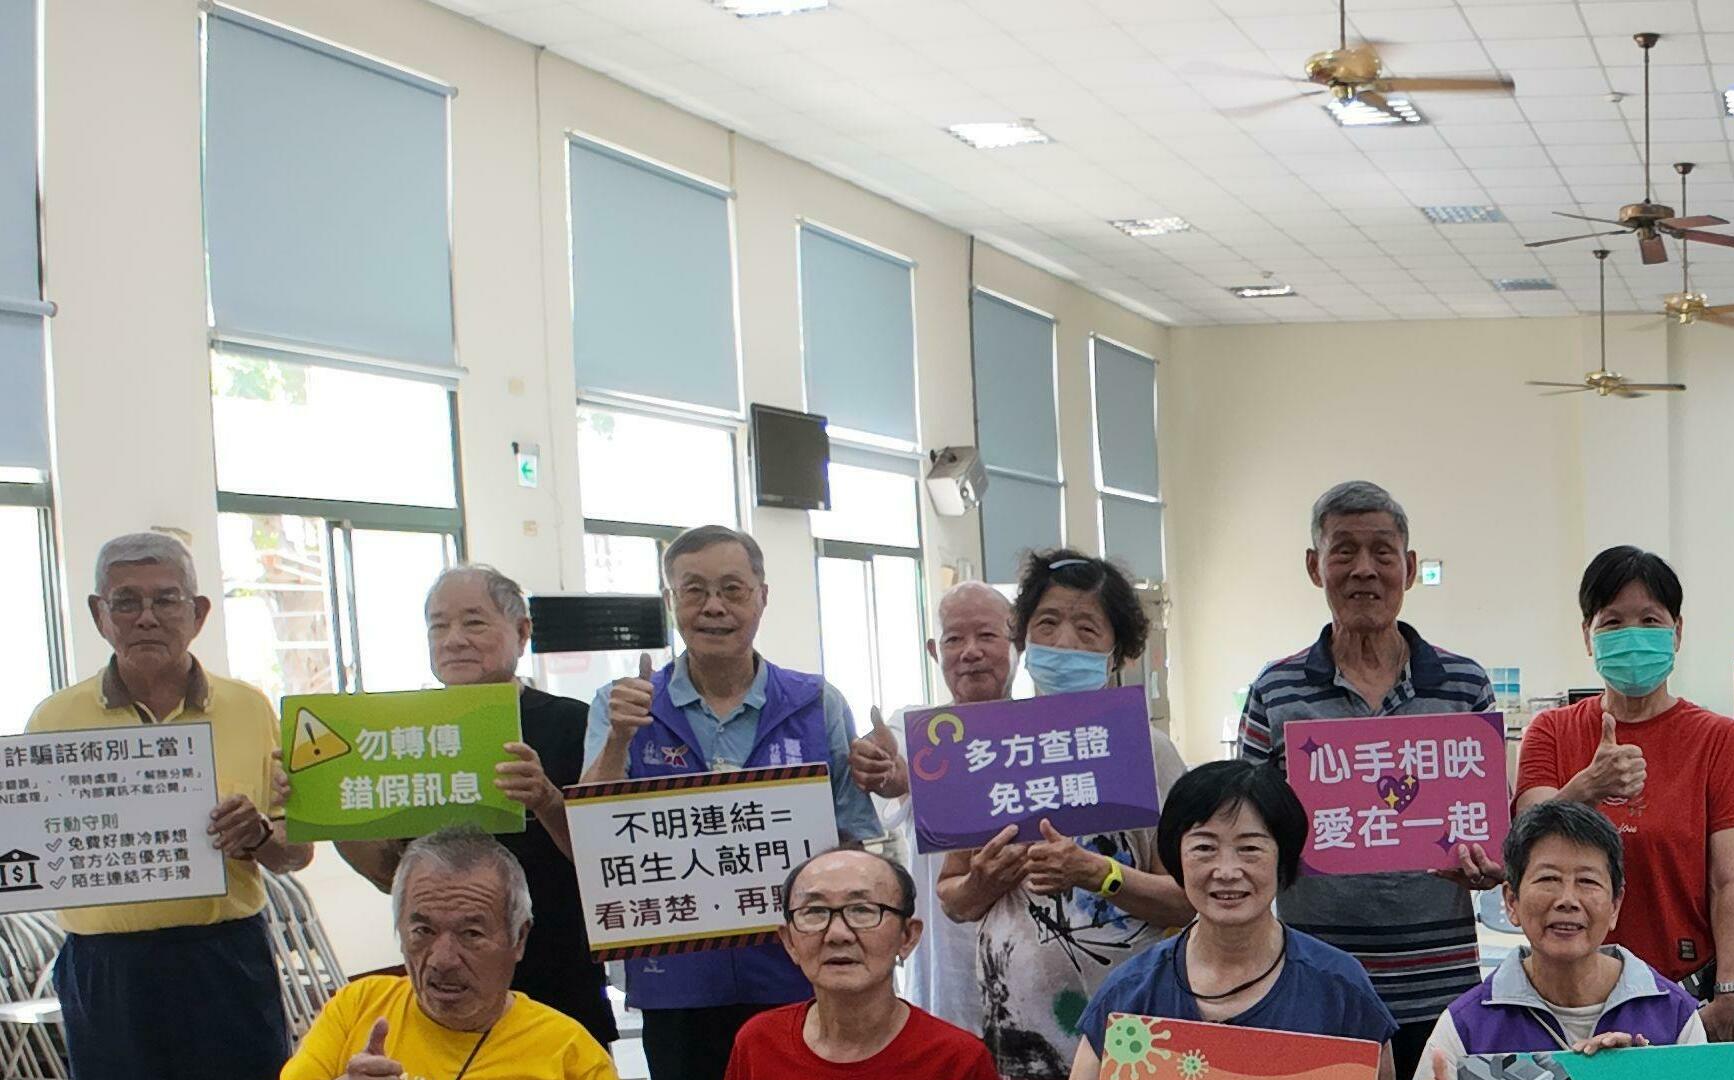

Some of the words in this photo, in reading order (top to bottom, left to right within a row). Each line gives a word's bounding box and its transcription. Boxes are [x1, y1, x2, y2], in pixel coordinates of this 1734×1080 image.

[4, 736, 195, 768] 詐騙話術別上當！
[354, 723, 462, 762] 勿轉傳
[964, 724, 1111, 773] 多方查證
[1308, 736, 1486, 784] 心手相映
[339, 770, 483, 812] 錯假訊息
[987, 770, 1099, 818] 免受騙
[44, 813, 119, 834] 行動守則
[68, 829, 188, 851] 免費好康冷靜想
[611, 800, 793, 844] 不明連結=
[1313, 800, 1490, 850] 愛在一起
[70, 848, 190, 870] 官方公告優先查
[71, 865, 191, 889] 陌生連結不手滑
[600, 839, 812, 888] 陌生人敲門！
